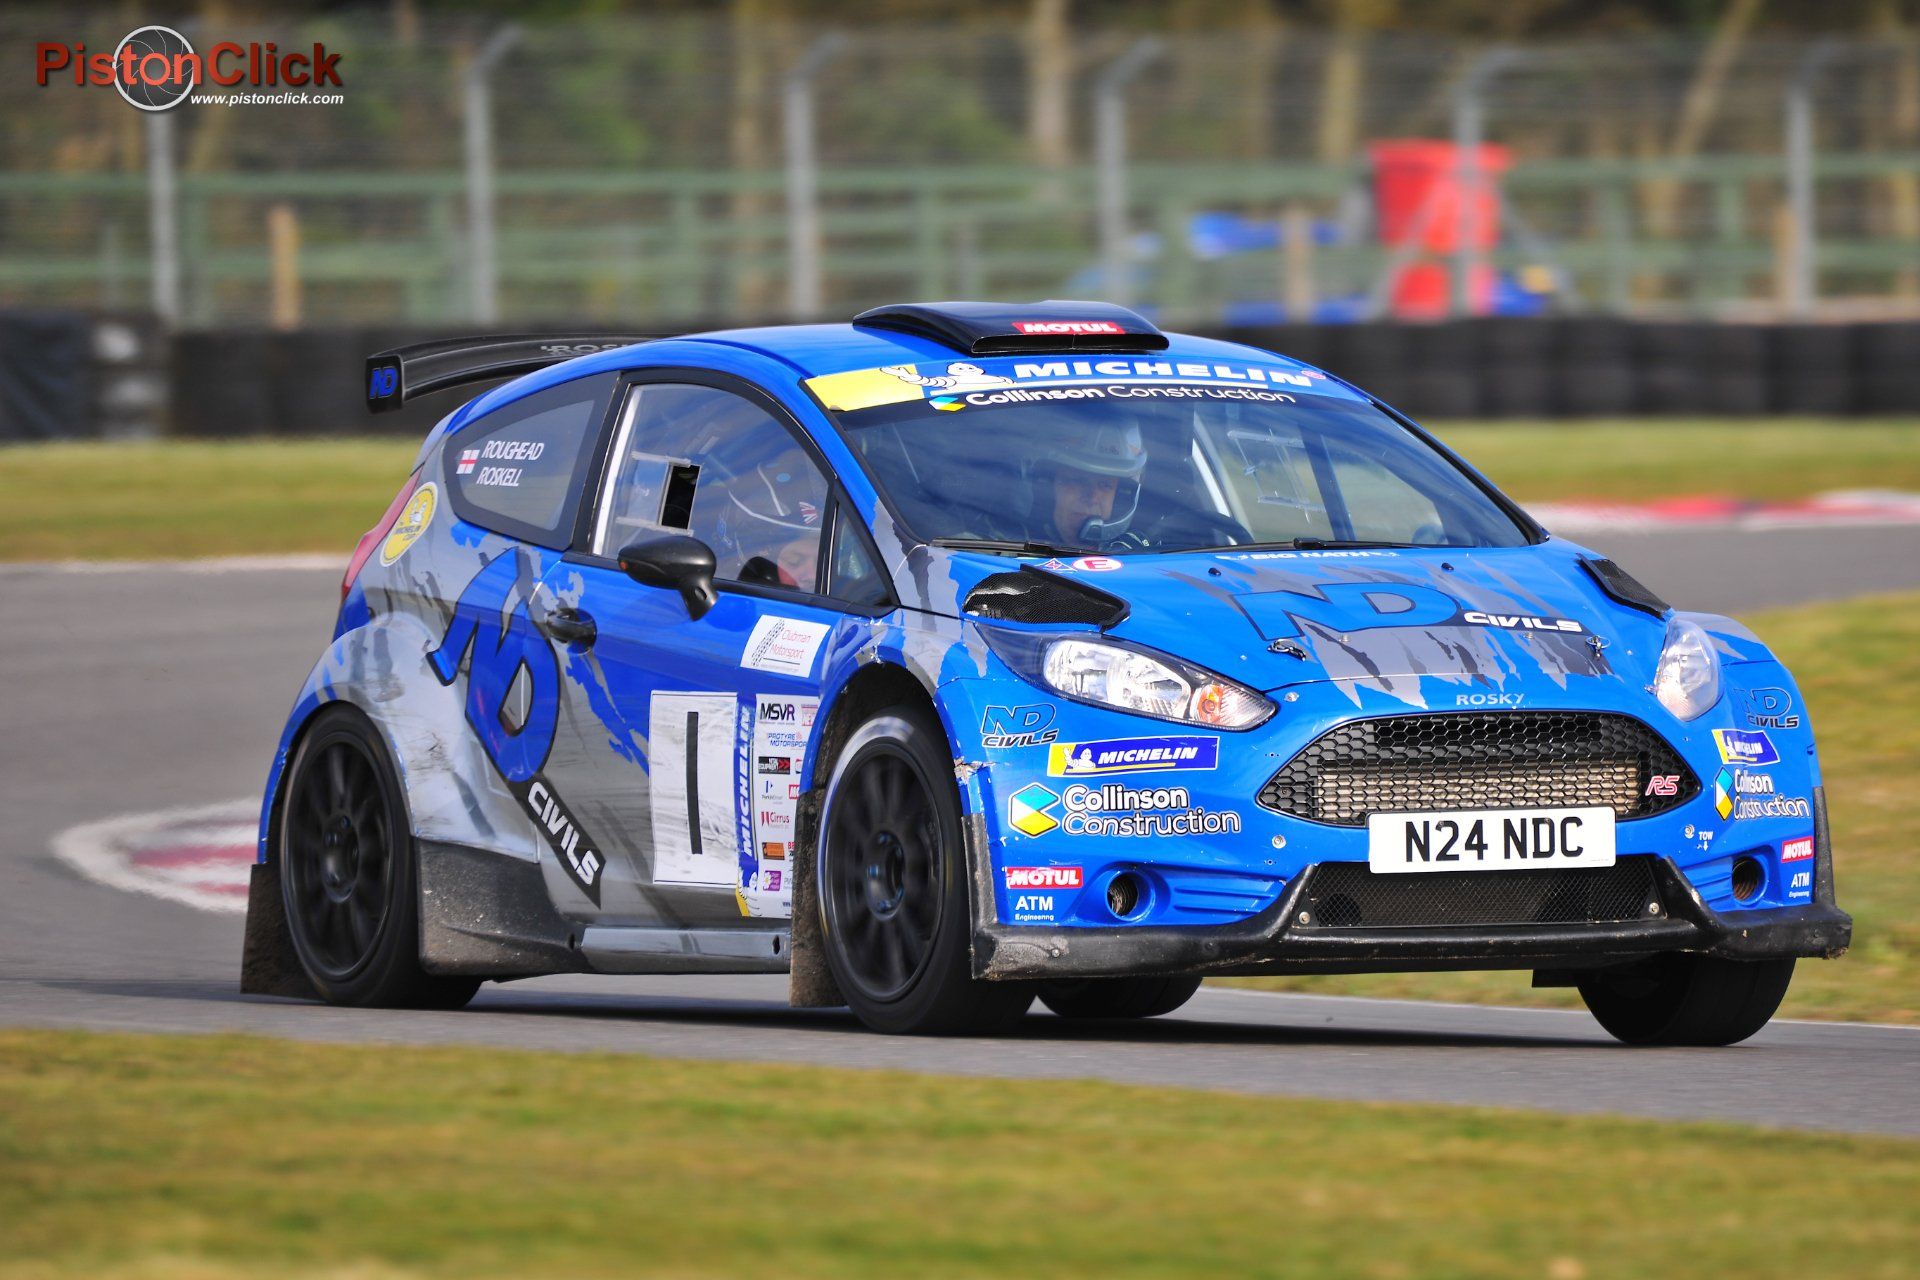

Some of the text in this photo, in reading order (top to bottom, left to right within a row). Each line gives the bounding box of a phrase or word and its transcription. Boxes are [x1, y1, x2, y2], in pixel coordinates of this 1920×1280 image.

[1023, 323, 1118, 333] MOTUL
[369, 366, 399, 399] ND
[1014, 361, 1312, 387] MICHELIN
[966, 385, 1296, 406] Collinson Construction
[481, 440, 545, 460] ROUGHEAD
[476, 467, 522, 487] ROSKELL
[1230, 581, 1583, 641] ND CIVILS
[782, 629, 811, 643] Clubman
[771, 643, 805, 659] Motorsport
[1455, 692, 1526, 706] ROSKY
[760, 703, 795, 721] MSVR
[980, 703, 1057, 736] ND
[1747, 714, 1800, 729] CIVILS
[768, 732, 796, 740] PROTYRE
[770, 740, 807, 748] MOTORSPOR
[981, 728, 1060, 748] CIVILS
[1097, 746, 1199, 765] MICHELIN
[739, 706, 753, 858] MICHELIN
[1645, 775, 1680, 797] RS
[1063, 783, 1189, 812] Collinson
[1733, 794, 1811, 820] Construction
[1063, 808, 1241, 836] Construction
[528, 781, 600, 886] CIVILS
[1406, 816, 1584, 863] N24 NDC
[1699, 831, 1714, 841] TOW
[1782, 840, 1813, 860] MOTUL
[1009, 868, 1080, 886] MOTUL
[1790, 871, 1810, 888] ATM
[1015, 895, 1054, 911] ATM
[1014, 913, 1055, 922] Engineering
